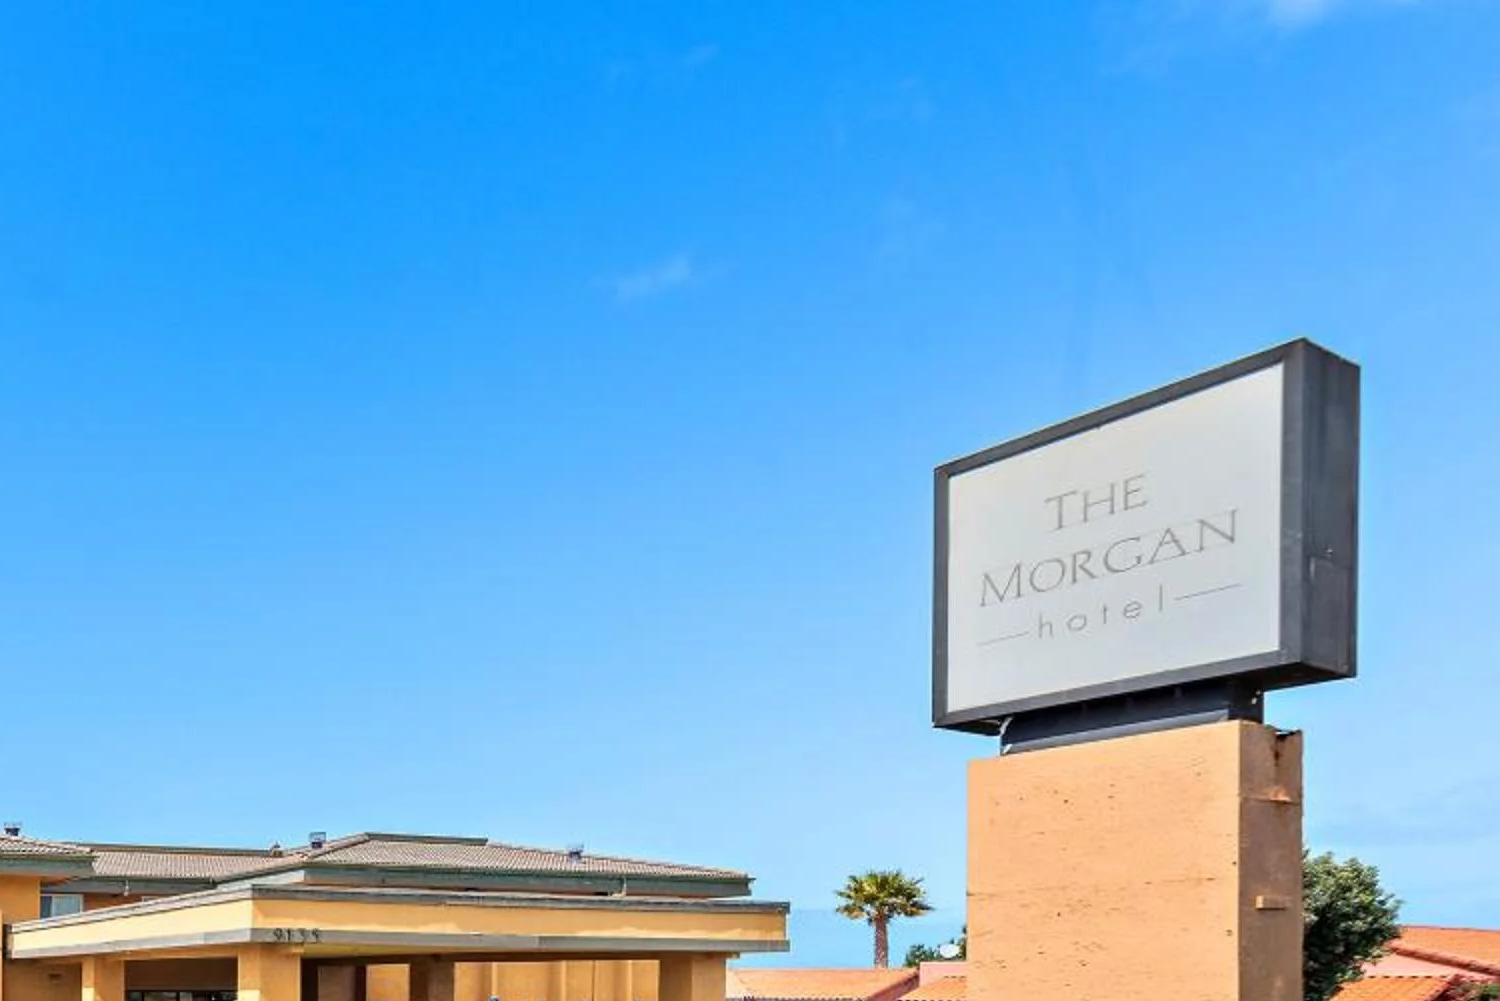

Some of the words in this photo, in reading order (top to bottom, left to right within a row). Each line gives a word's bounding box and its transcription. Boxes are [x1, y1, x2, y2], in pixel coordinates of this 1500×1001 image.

[1044, 474, 1148, 531] THE
[980, 508, 1238, 607] MORGAN
[1038, 584, 1163, 639] hotel
